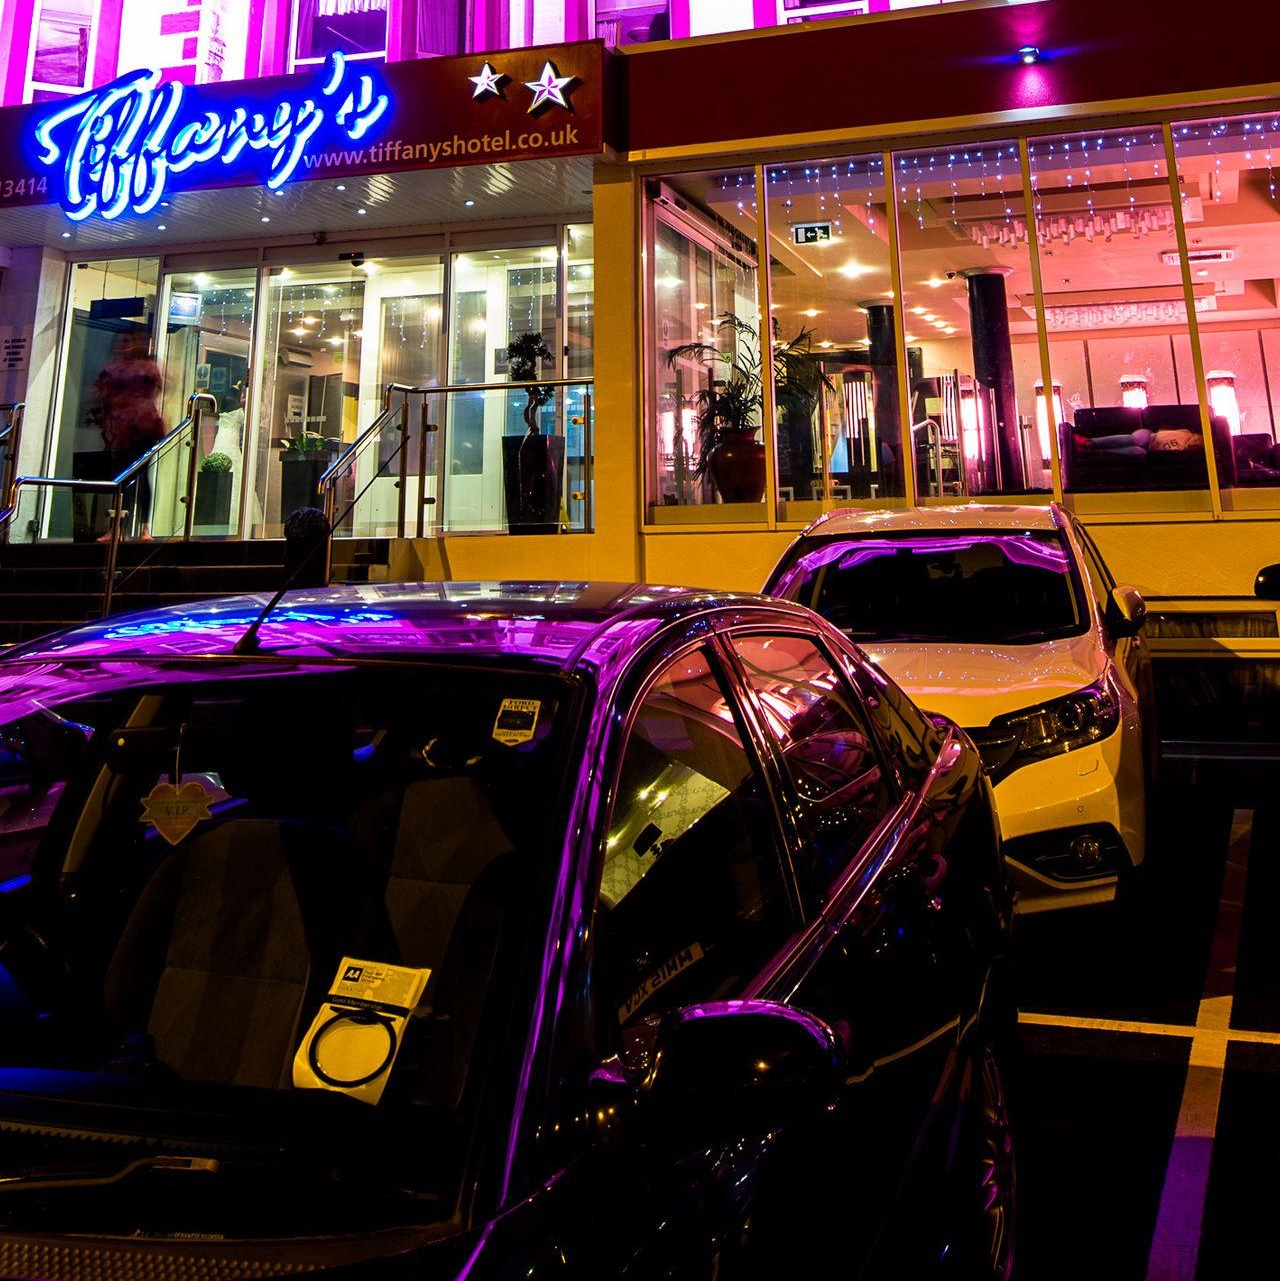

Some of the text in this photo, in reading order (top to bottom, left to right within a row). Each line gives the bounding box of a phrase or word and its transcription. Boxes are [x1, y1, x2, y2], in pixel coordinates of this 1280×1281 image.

[35, 50, 389, 220] Tiffany's
[303, 123, 579, 168] www.tiffanyshotel.co.uk
[345, 969, 360, 979] AA
